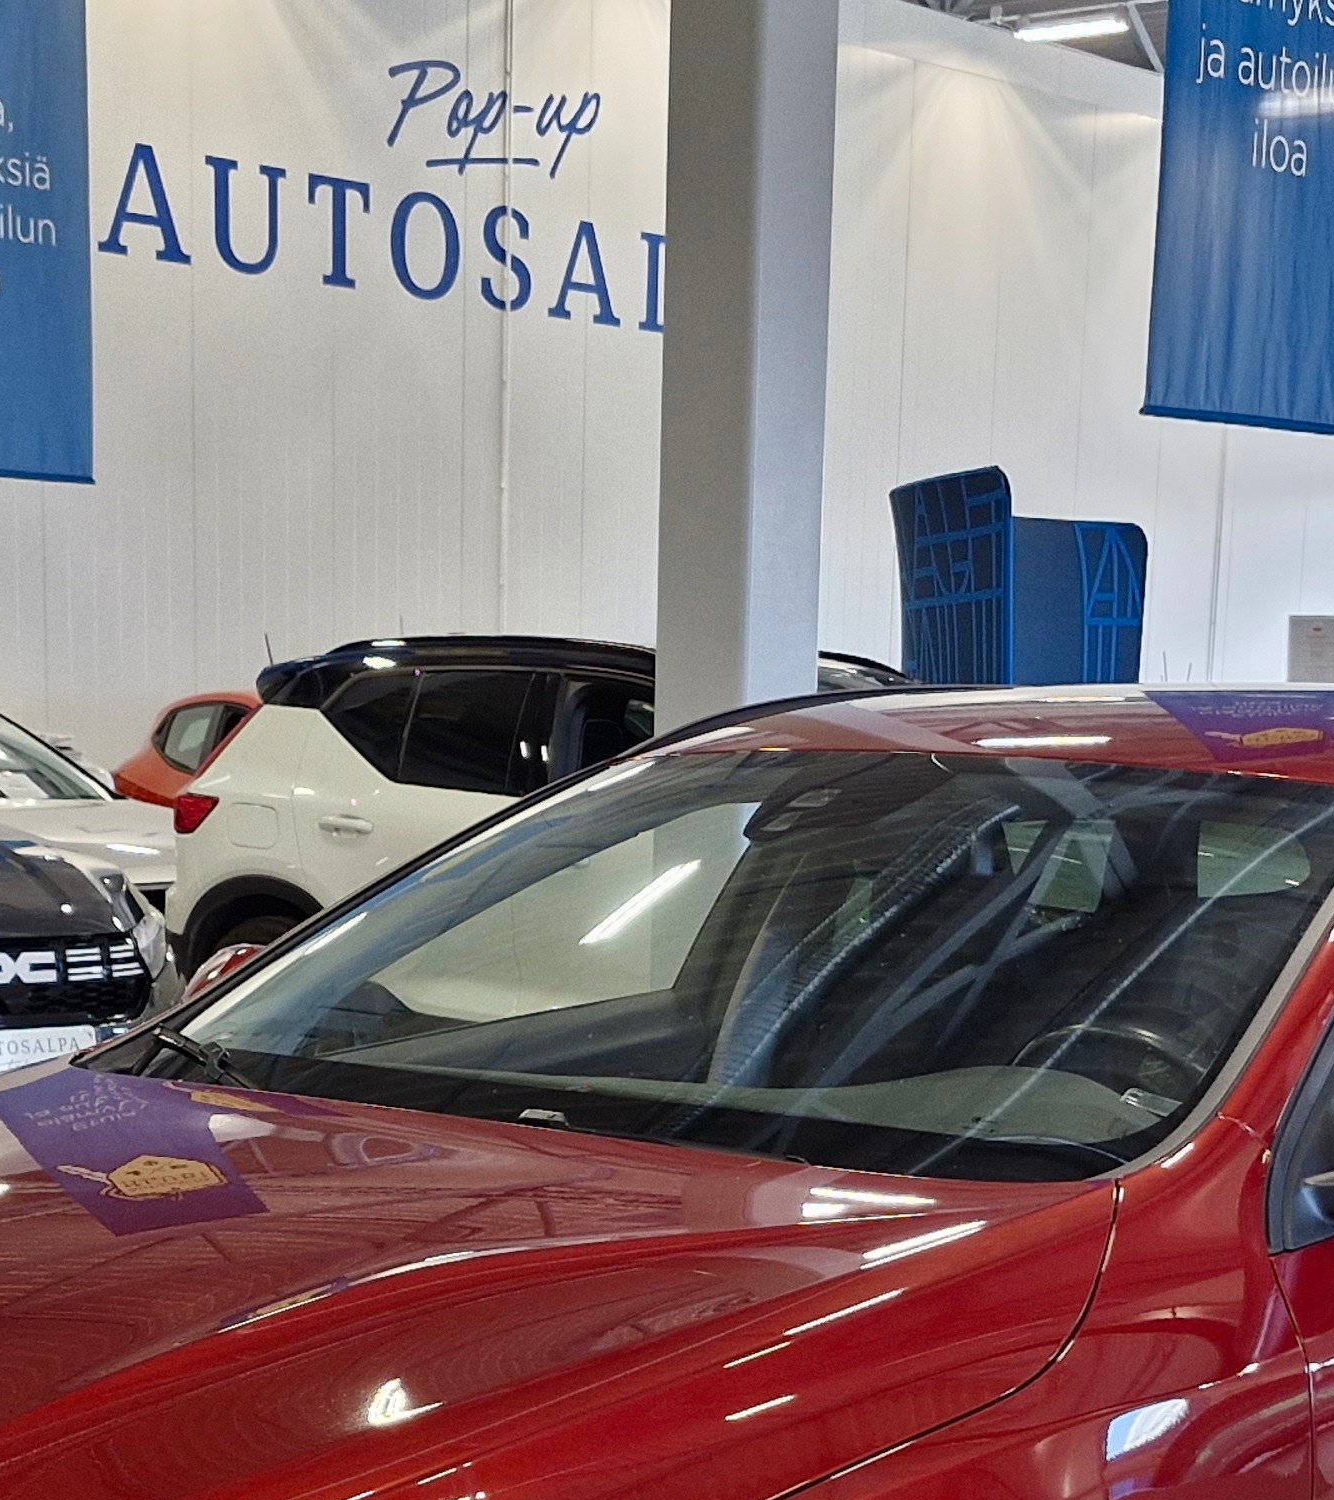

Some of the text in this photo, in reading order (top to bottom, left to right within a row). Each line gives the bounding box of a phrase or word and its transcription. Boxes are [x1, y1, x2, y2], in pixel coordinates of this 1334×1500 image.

[1196, 23, 1226, 84] ja
[387, 59, 601, 180] Pop-up
[1252, 118, 1307, 177] iloa
